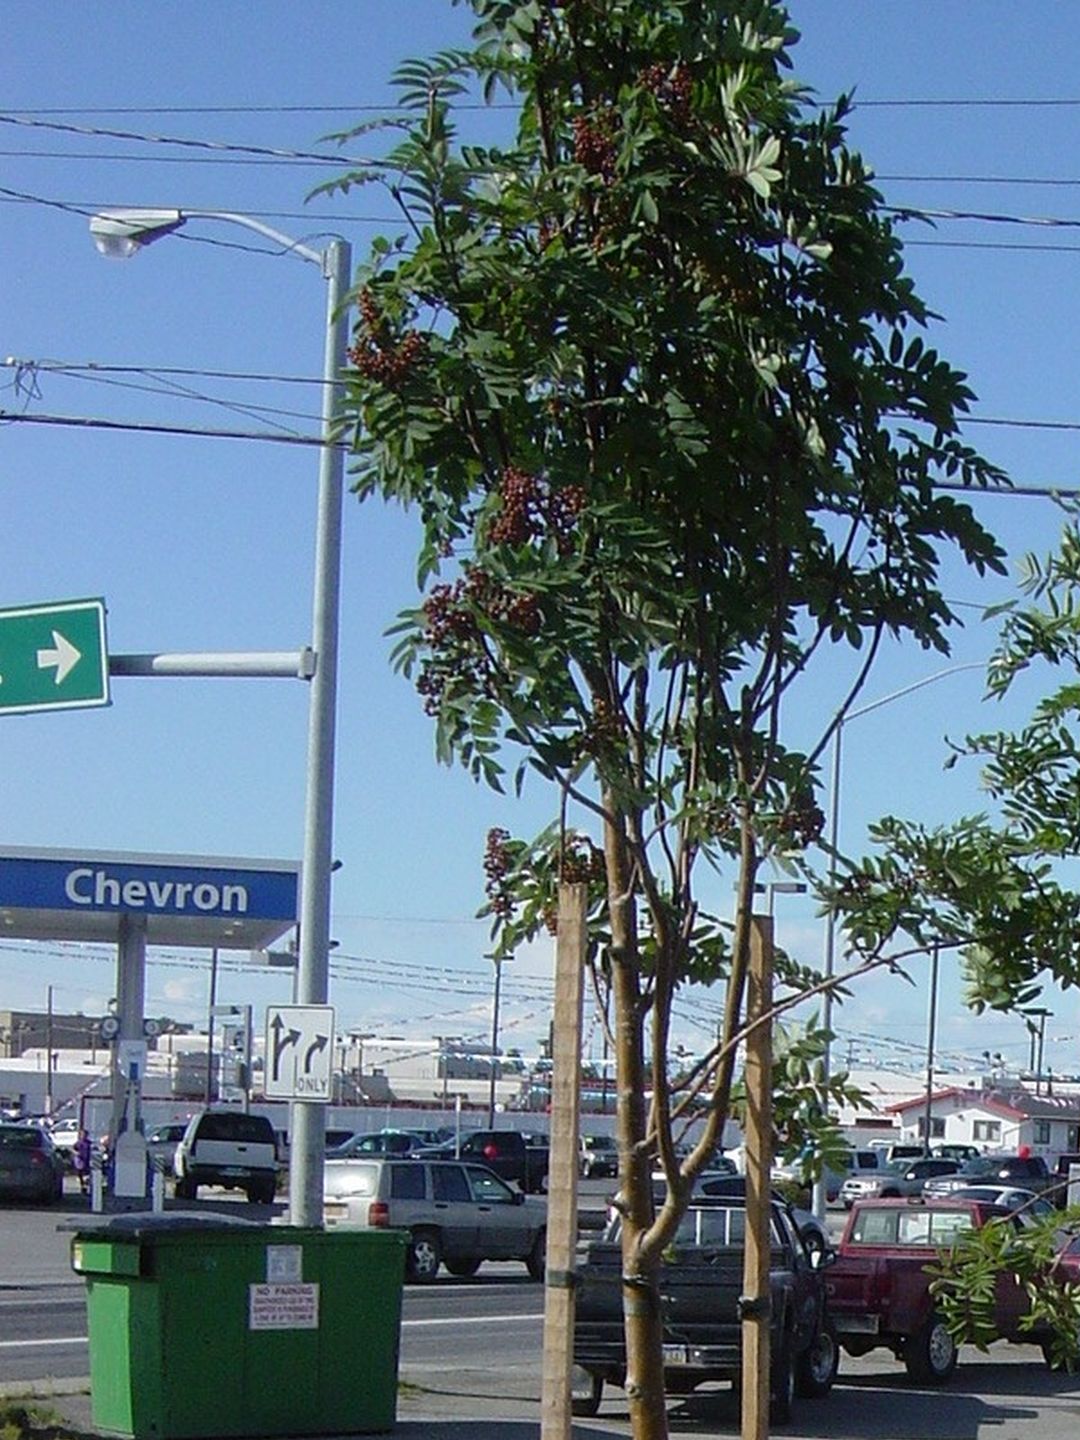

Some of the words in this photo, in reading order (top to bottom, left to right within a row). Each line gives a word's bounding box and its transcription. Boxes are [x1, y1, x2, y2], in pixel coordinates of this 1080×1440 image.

[65, 868, 248, 912] Chevron
[298, 1078, 328, 1093] ONLY
[256, 1286, 271, 1296] NO
